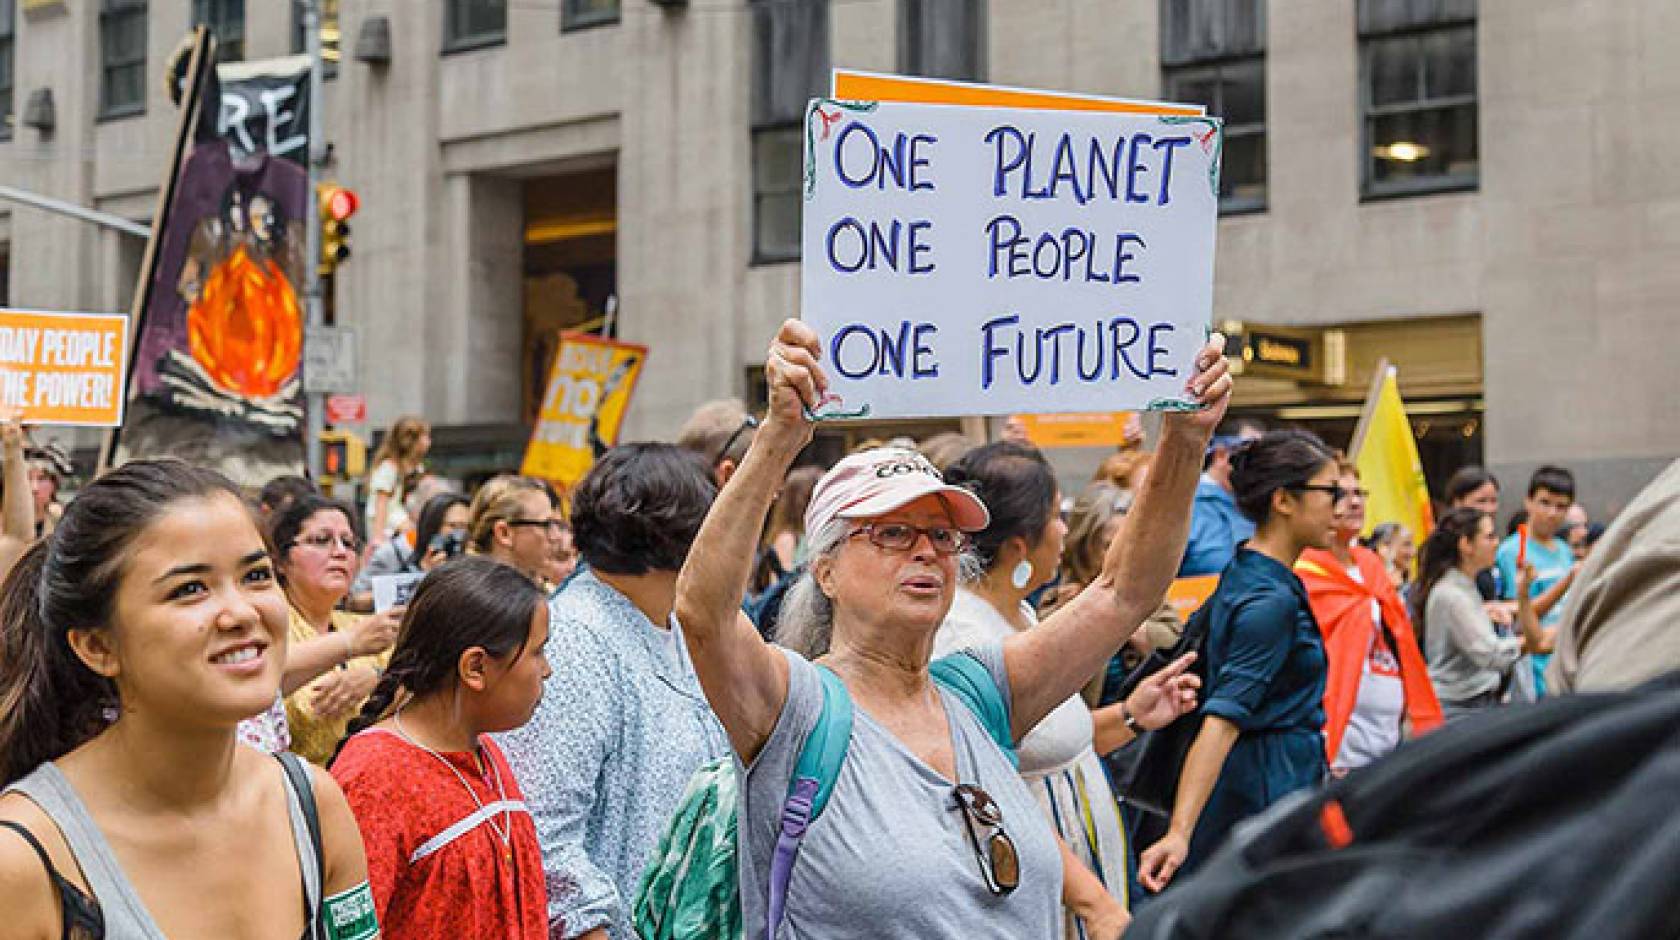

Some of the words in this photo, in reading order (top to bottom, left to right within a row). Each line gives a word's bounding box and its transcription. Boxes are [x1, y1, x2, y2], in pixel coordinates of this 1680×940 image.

[834, 121, 939, 192] ONE
[984, 124, 1193, 206] PLANET
[825, 217, 937, 275] ONE
[984, 214, 1147, 285] PEOPLE
[41, 329, 116, 367] PEOPLE
[830, 320, 939, 381] ONE
[981, 314, 1179, 391] FUTURE
[34, 371, 113, 410] POWER!
